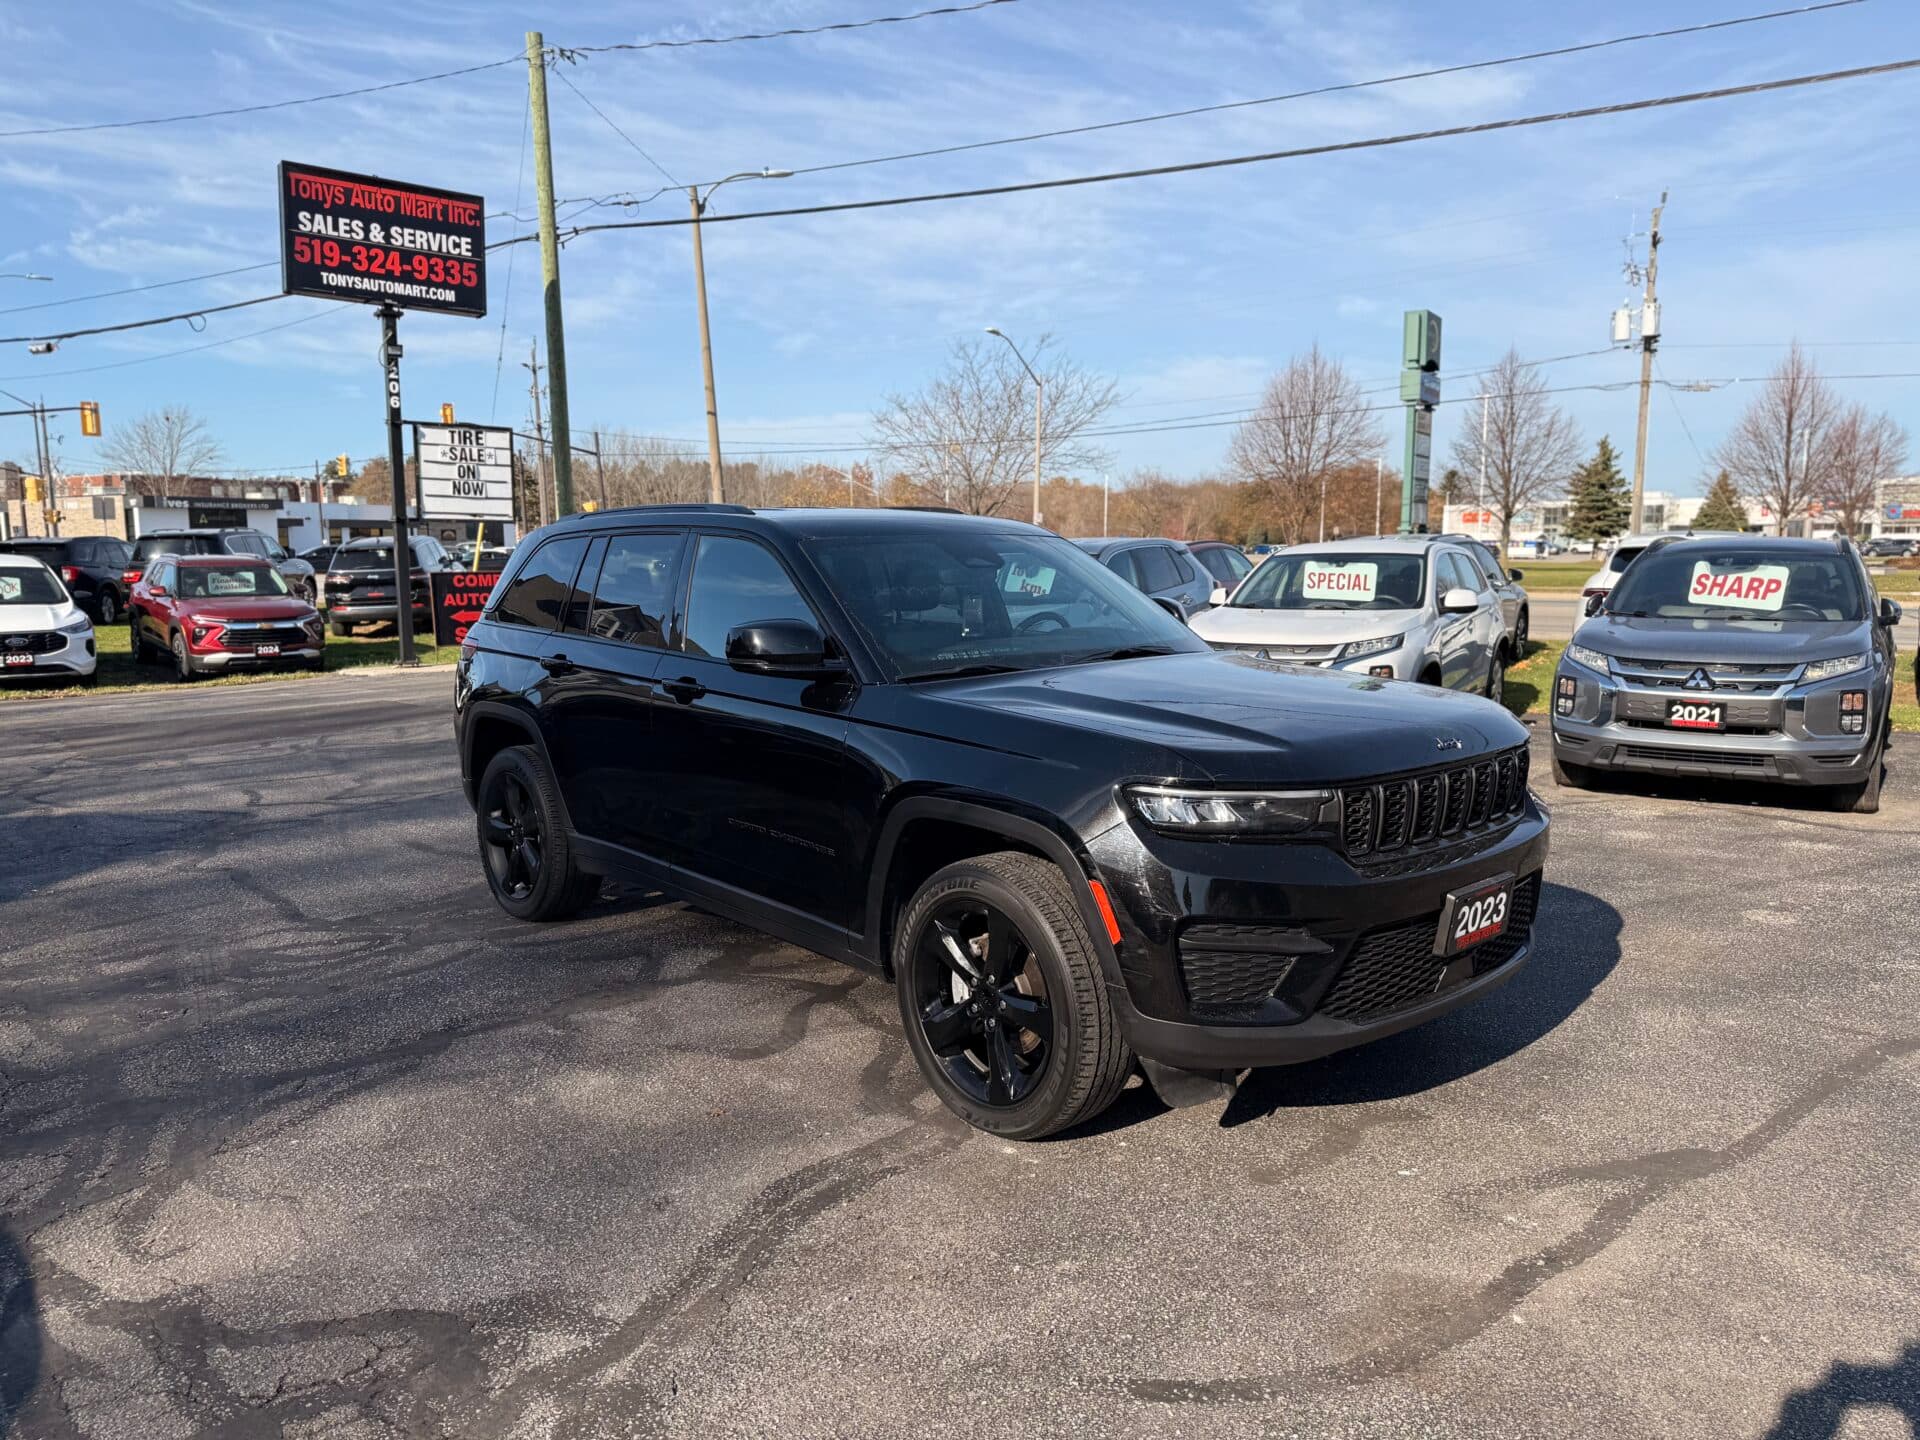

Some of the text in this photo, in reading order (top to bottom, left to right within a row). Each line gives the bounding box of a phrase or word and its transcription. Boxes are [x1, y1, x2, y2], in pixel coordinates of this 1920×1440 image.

[288, 172, 481, 227] Tonys Auto Mart Inc.
[297, 211, 472, 256] SALES & SERVICE
[294, 236, 478, 287] 519-324-9335
[320, 271, 456, 302] TONYSAUTOMART.COM
[448, 430, 484, 446] TIRE
[457, 464, 476, 480] ON
[452, 481, 484, 497] NOW
[1307, 571, 1371, 592] SPECIAL
[1692, 572, 1782, 601] SHARP
[5, 654, 34, 664] 2023
[257, 645, 280, 655] 2024
[1671, 704, 1722, 724] 2021
[1454, 891, 1508, 940] 2023
